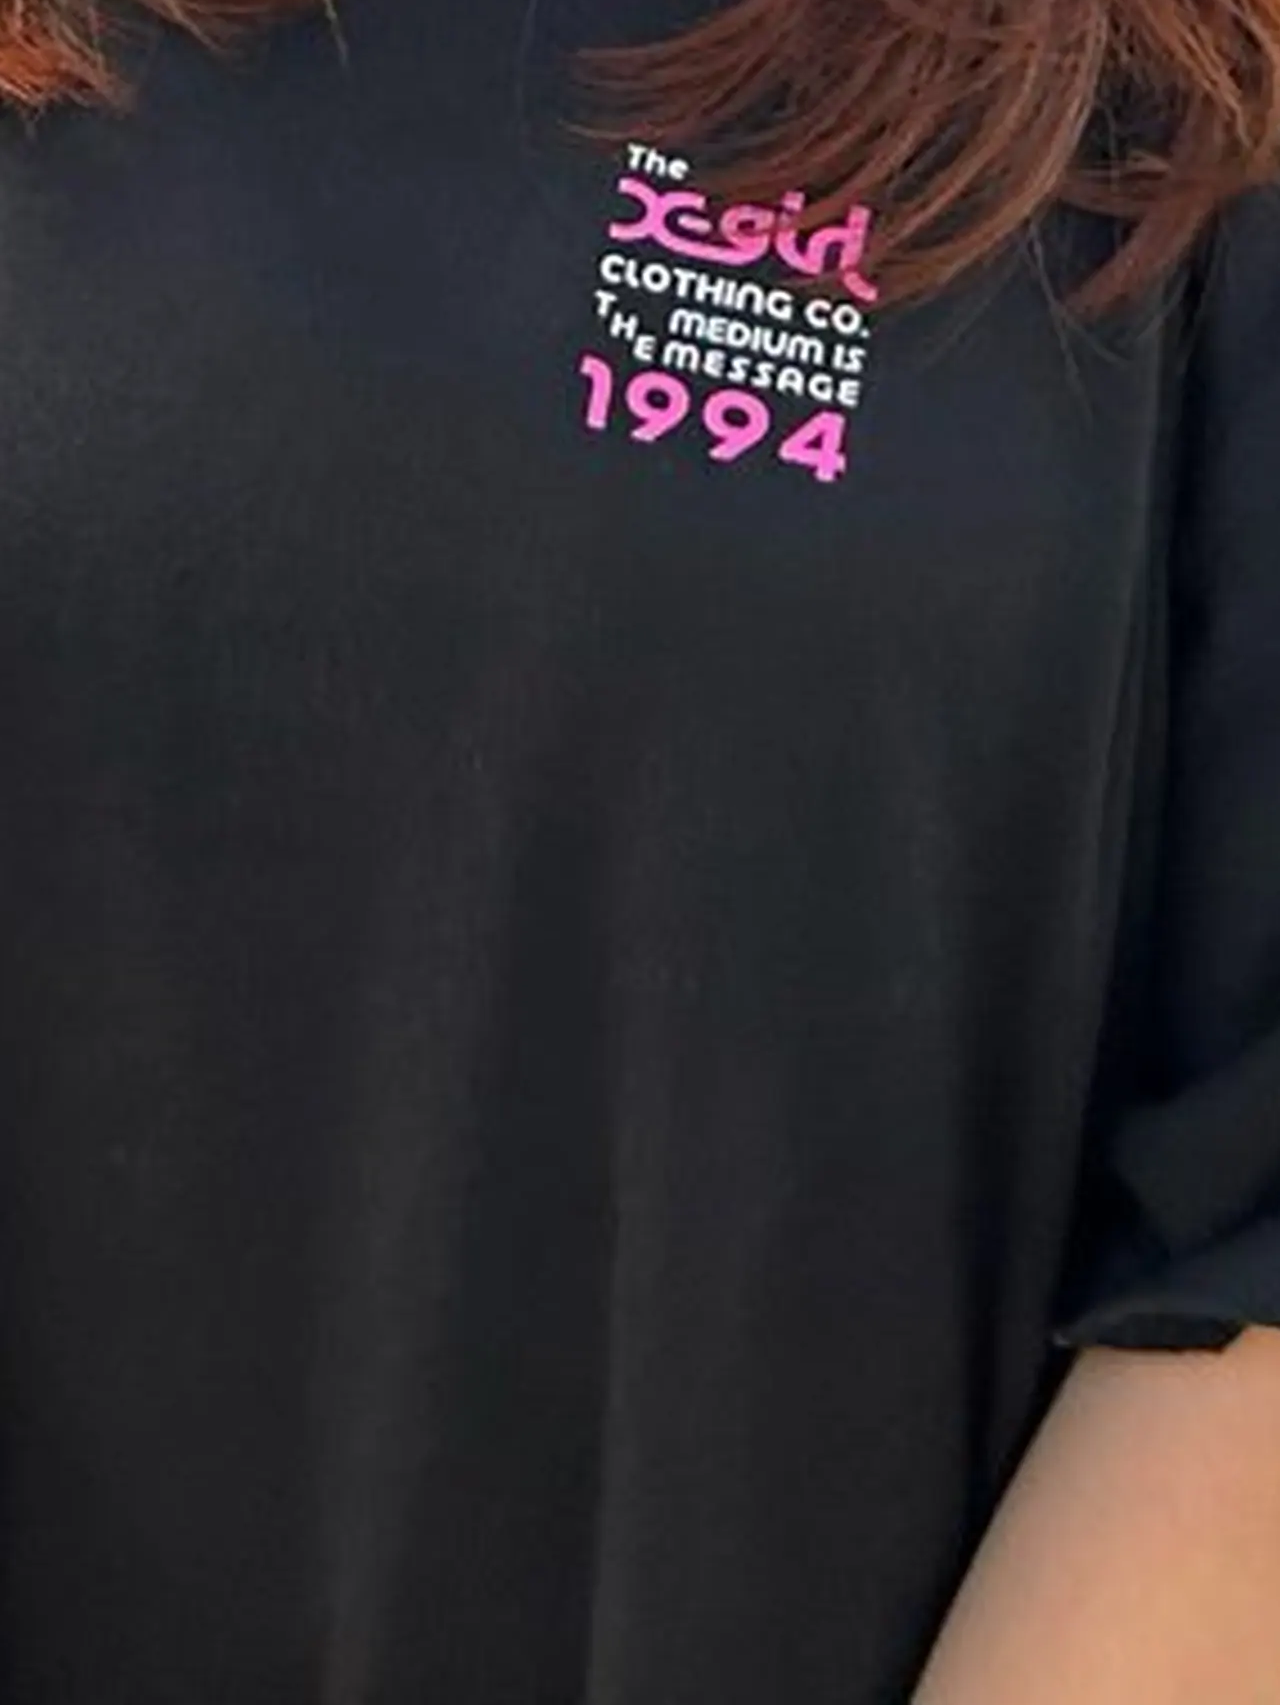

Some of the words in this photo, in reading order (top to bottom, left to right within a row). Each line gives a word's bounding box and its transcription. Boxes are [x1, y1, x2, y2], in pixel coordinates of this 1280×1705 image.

[627, 143, 689, 180] The
[609, 177, 878, 302] X-girl
[594, 290, 657, 360] THE
[669, 308, 823, 366] MEDIUM
[833, 343, 867, 372] IS
[600, 254, 793, 320] CLOTHING
[805, 299, 870, 338] CO.
[663, 341, 861, 408] MESSAGE
[580, 355, 846, 482] 1994
